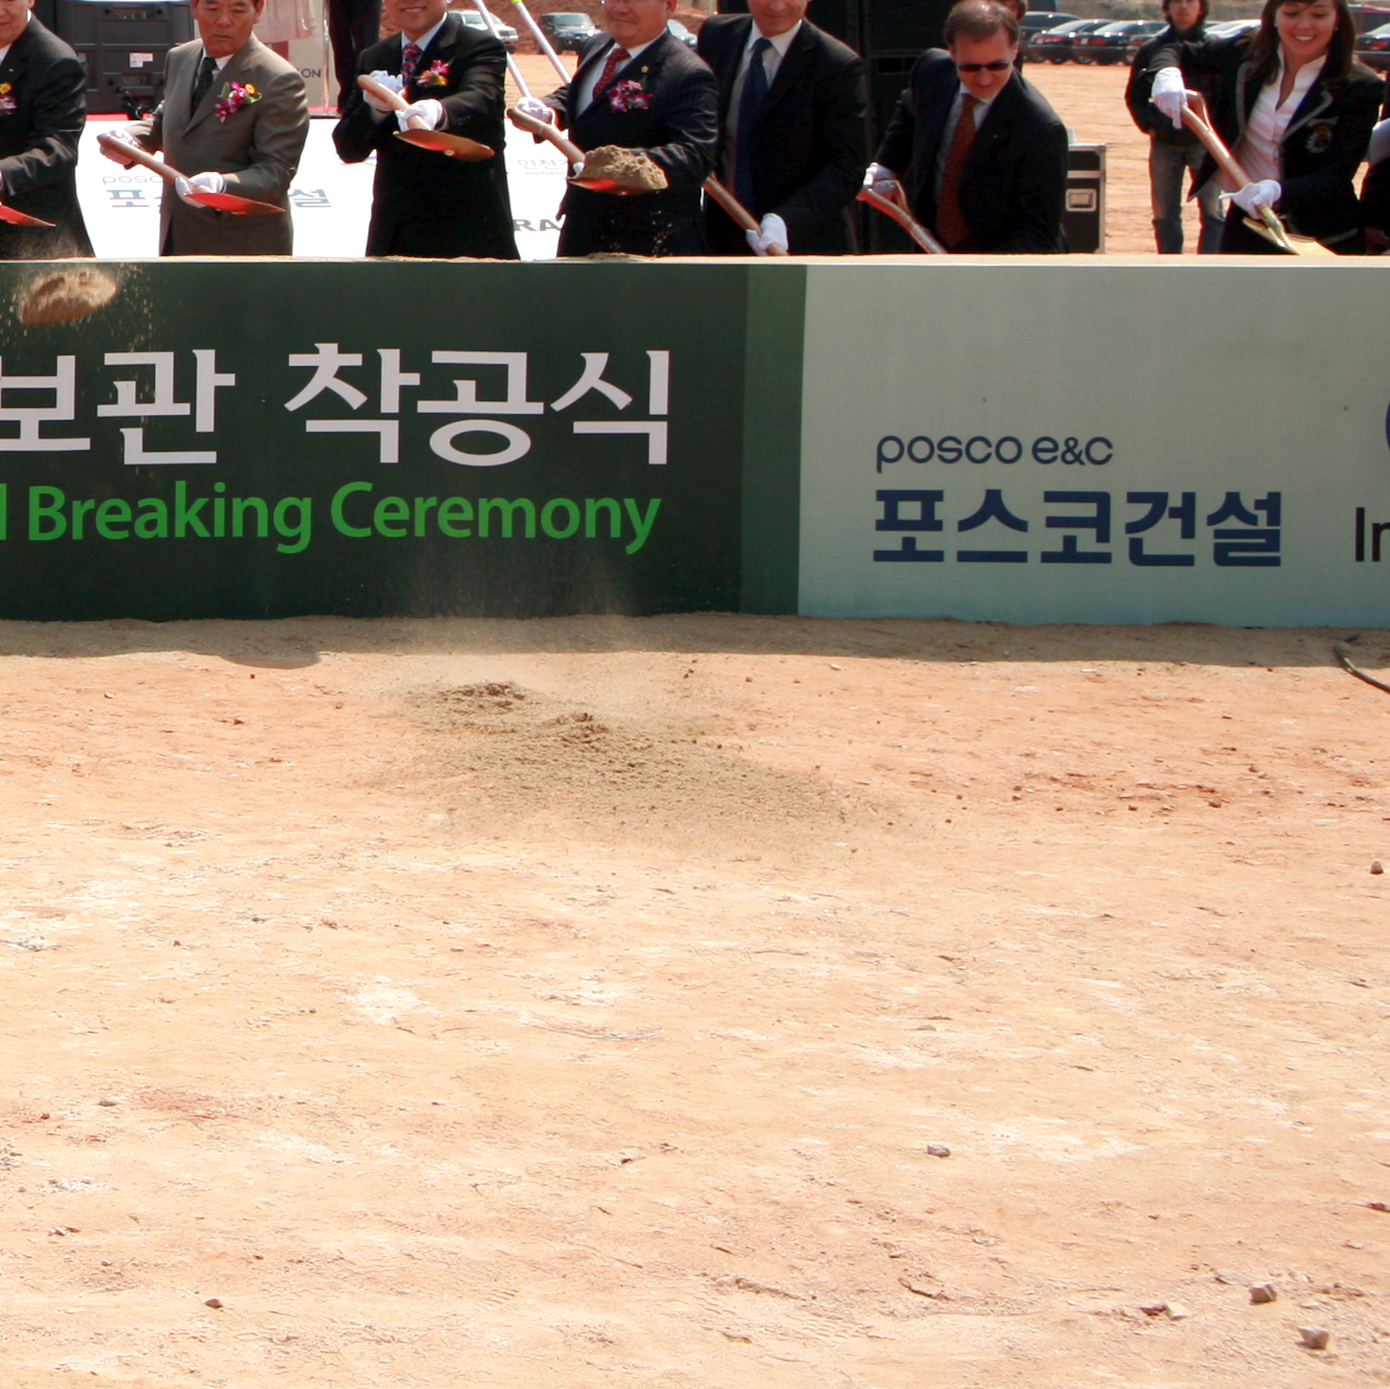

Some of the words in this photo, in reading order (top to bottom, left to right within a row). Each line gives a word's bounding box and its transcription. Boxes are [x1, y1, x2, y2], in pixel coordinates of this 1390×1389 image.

[283, 341, 670, 466] 착공식
[875, 435, 1023, 474] posco
[1031, 435, 1114, 466] e&c
[27, 481, 313, 554] Breaking
[329, 481, 662, 554] Ceremony
[873, 488, 1282, 568] 포스코건설
